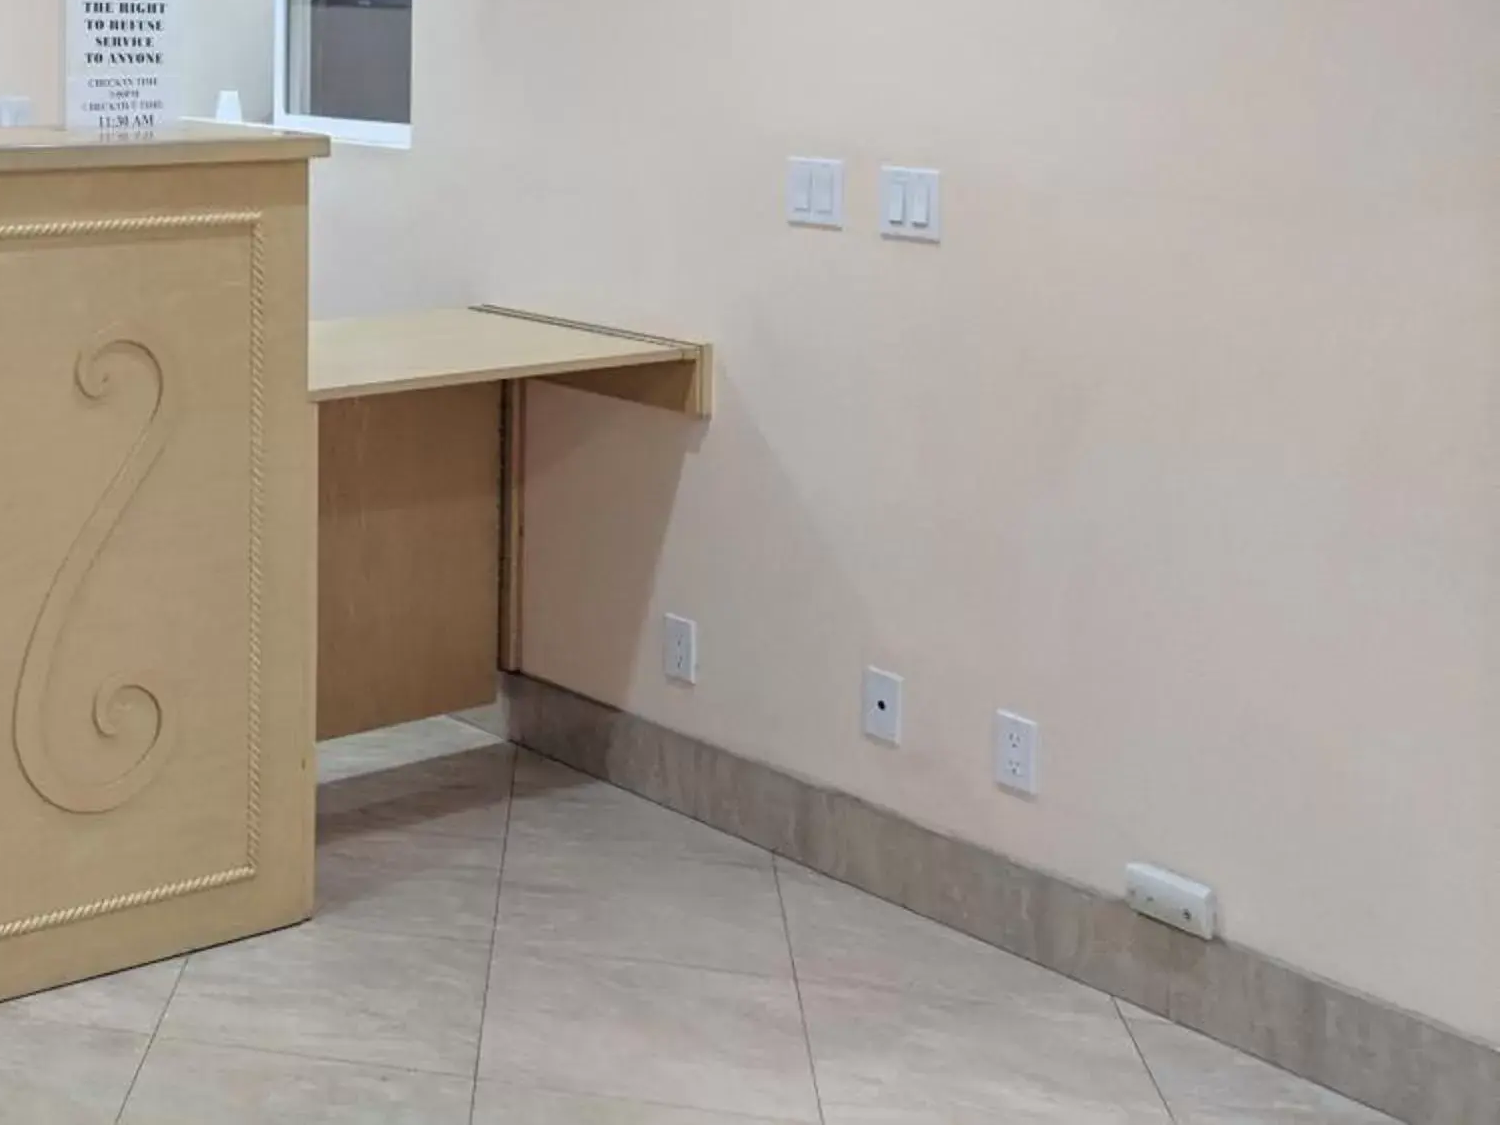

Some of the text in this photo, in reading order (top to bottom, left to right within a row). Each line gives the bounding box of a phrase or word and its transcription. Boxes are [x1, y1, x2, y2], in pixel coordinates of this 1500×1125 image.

[83, 1, 167, 14] THE RIGHT
[84, 19, 164, 32] TO REFUSE
[95, 36, 155, 48] SERVICE
[85, 52, 164, 64] TO ANYONE
[133, 114, 155, 128] AM
